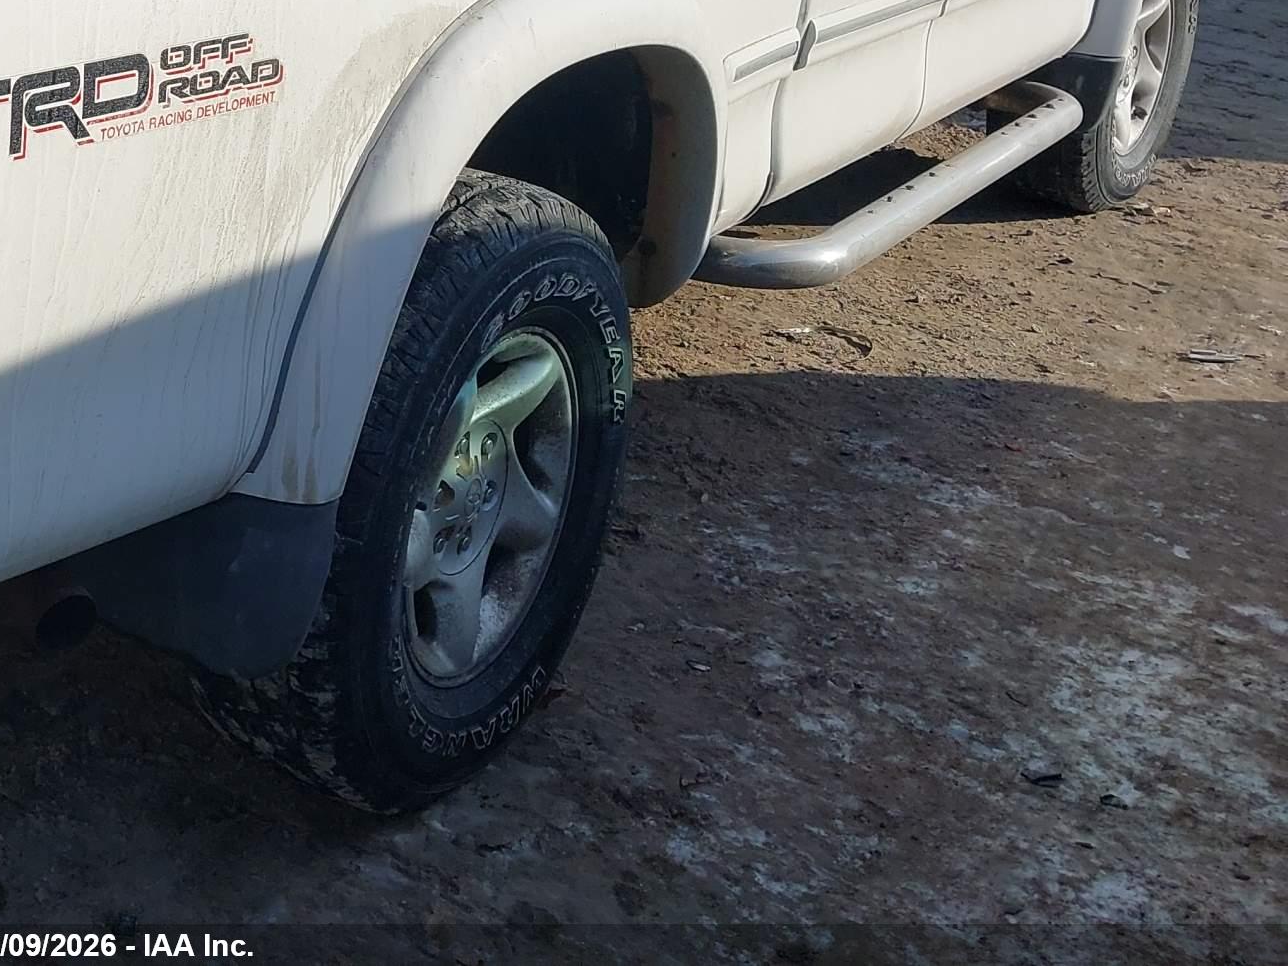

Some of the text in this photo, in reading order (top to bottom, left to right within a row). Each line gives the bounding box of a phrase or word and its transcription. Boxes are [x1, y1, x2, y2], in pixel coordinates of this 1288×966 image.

[159, 33, 253, 75] OFF
[158, 58, 284, 108] ROAD
[100, 90, 276, 141] TOYOTA RACING DEVELOPMENT
